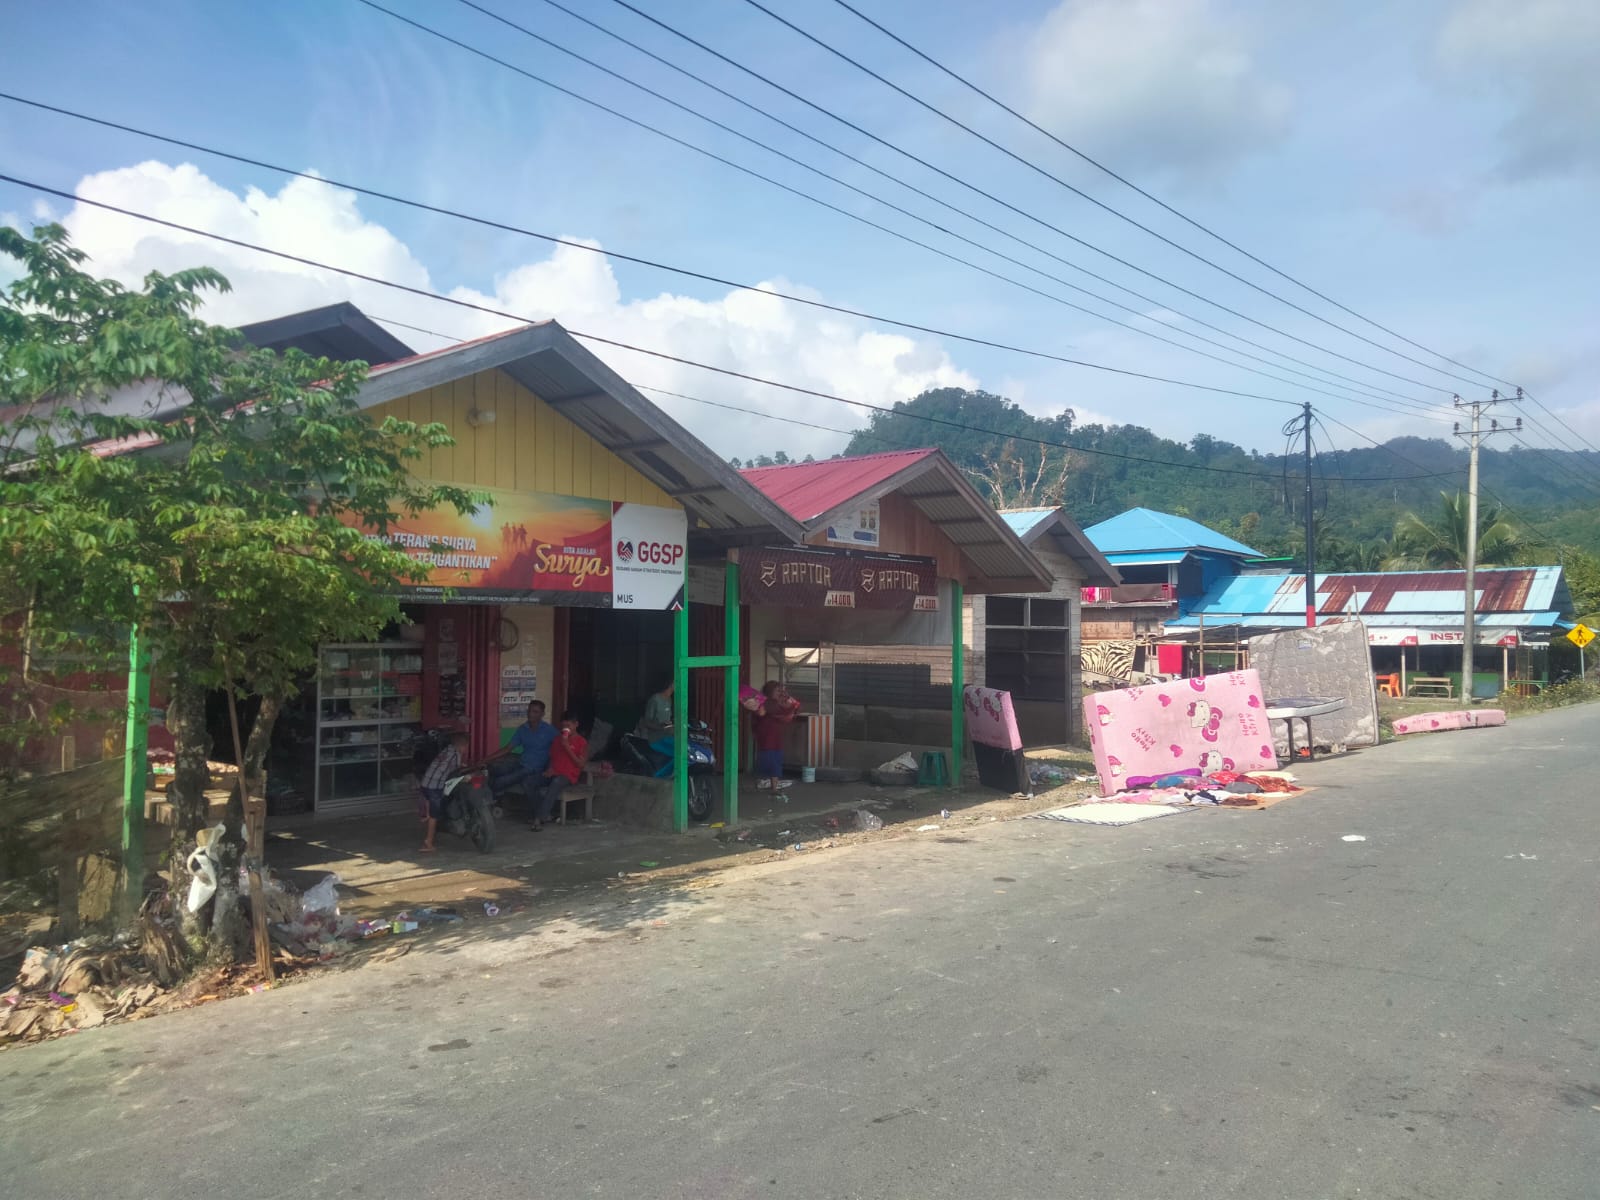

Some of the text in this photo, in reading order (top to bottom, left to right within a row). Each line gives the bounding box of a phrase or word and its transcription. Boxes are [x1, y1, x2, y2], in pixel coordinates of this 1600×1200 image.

[441, 535, 477, 551] SURYA
[637, 541, 684, 565] GGSP
[534, 543, 610, 588] Surya
[781, 562, 832, 588] RAPTOR
[878, 570, 920, 593] RAPTOR
[616, 594, 634, 604] MUS
[1430, 632, 1465, 641] INST
